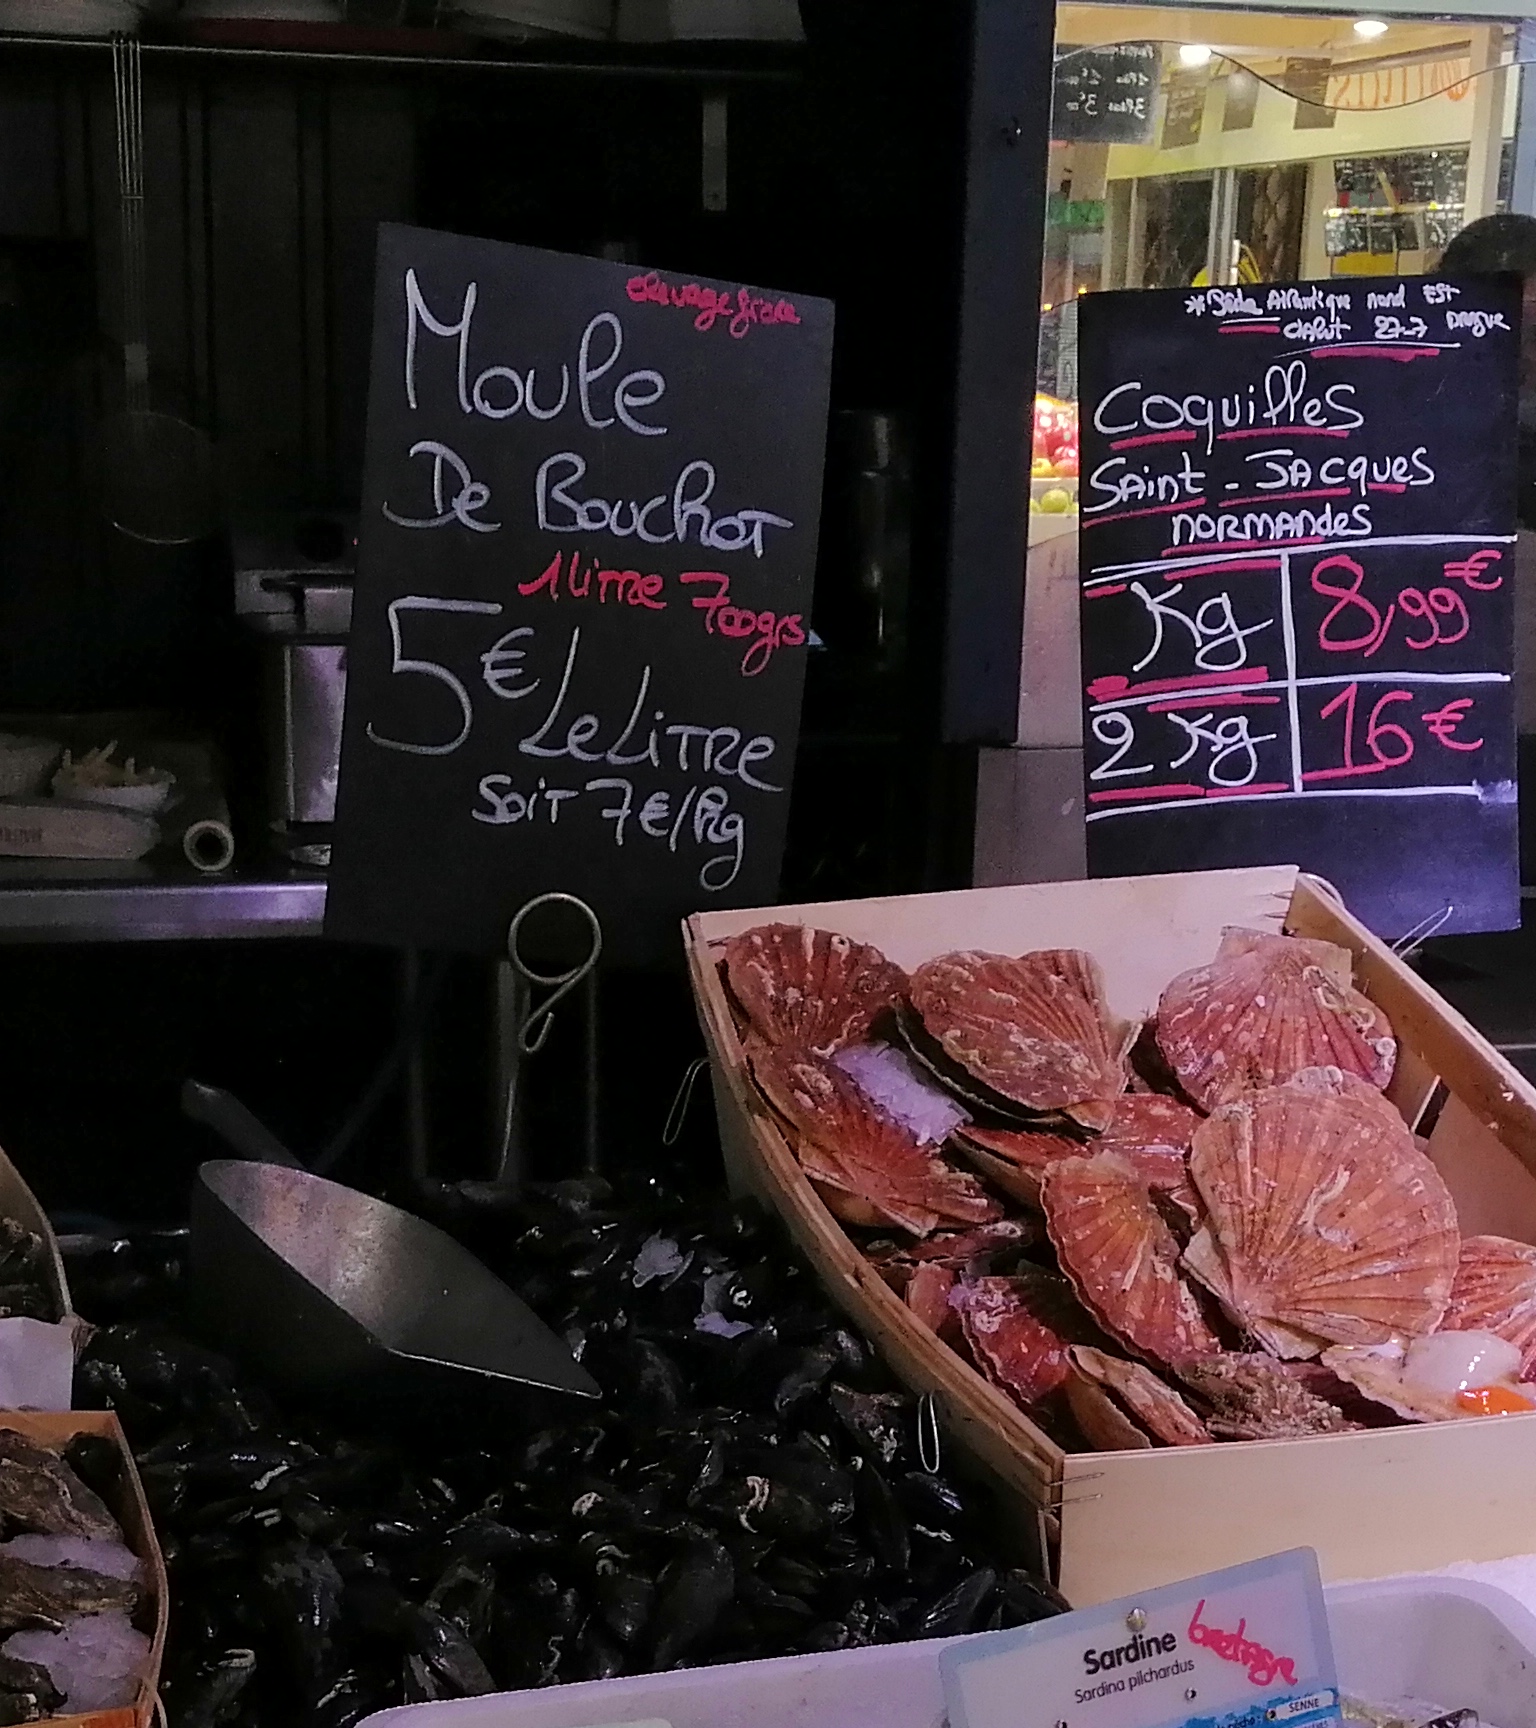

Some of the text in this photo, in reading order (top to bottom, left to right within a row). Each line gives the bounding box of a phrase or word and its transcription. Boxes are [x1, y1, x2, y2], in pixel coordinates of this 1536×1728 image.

[406, 268, 668, 436] Moule
[1094, 360, 1365, 456] Coquilles
[382, 440, 501, 533] De
[1083, 452, 1206, 512] Saint
[1090, 711, 1155, 780] 2
[1074, 1657, 1195, 1704] Sardina pilchardus
[1083, 1631, 1177, 1675] Sardine
[1289, 1698, 1320, 1713] SENNE
